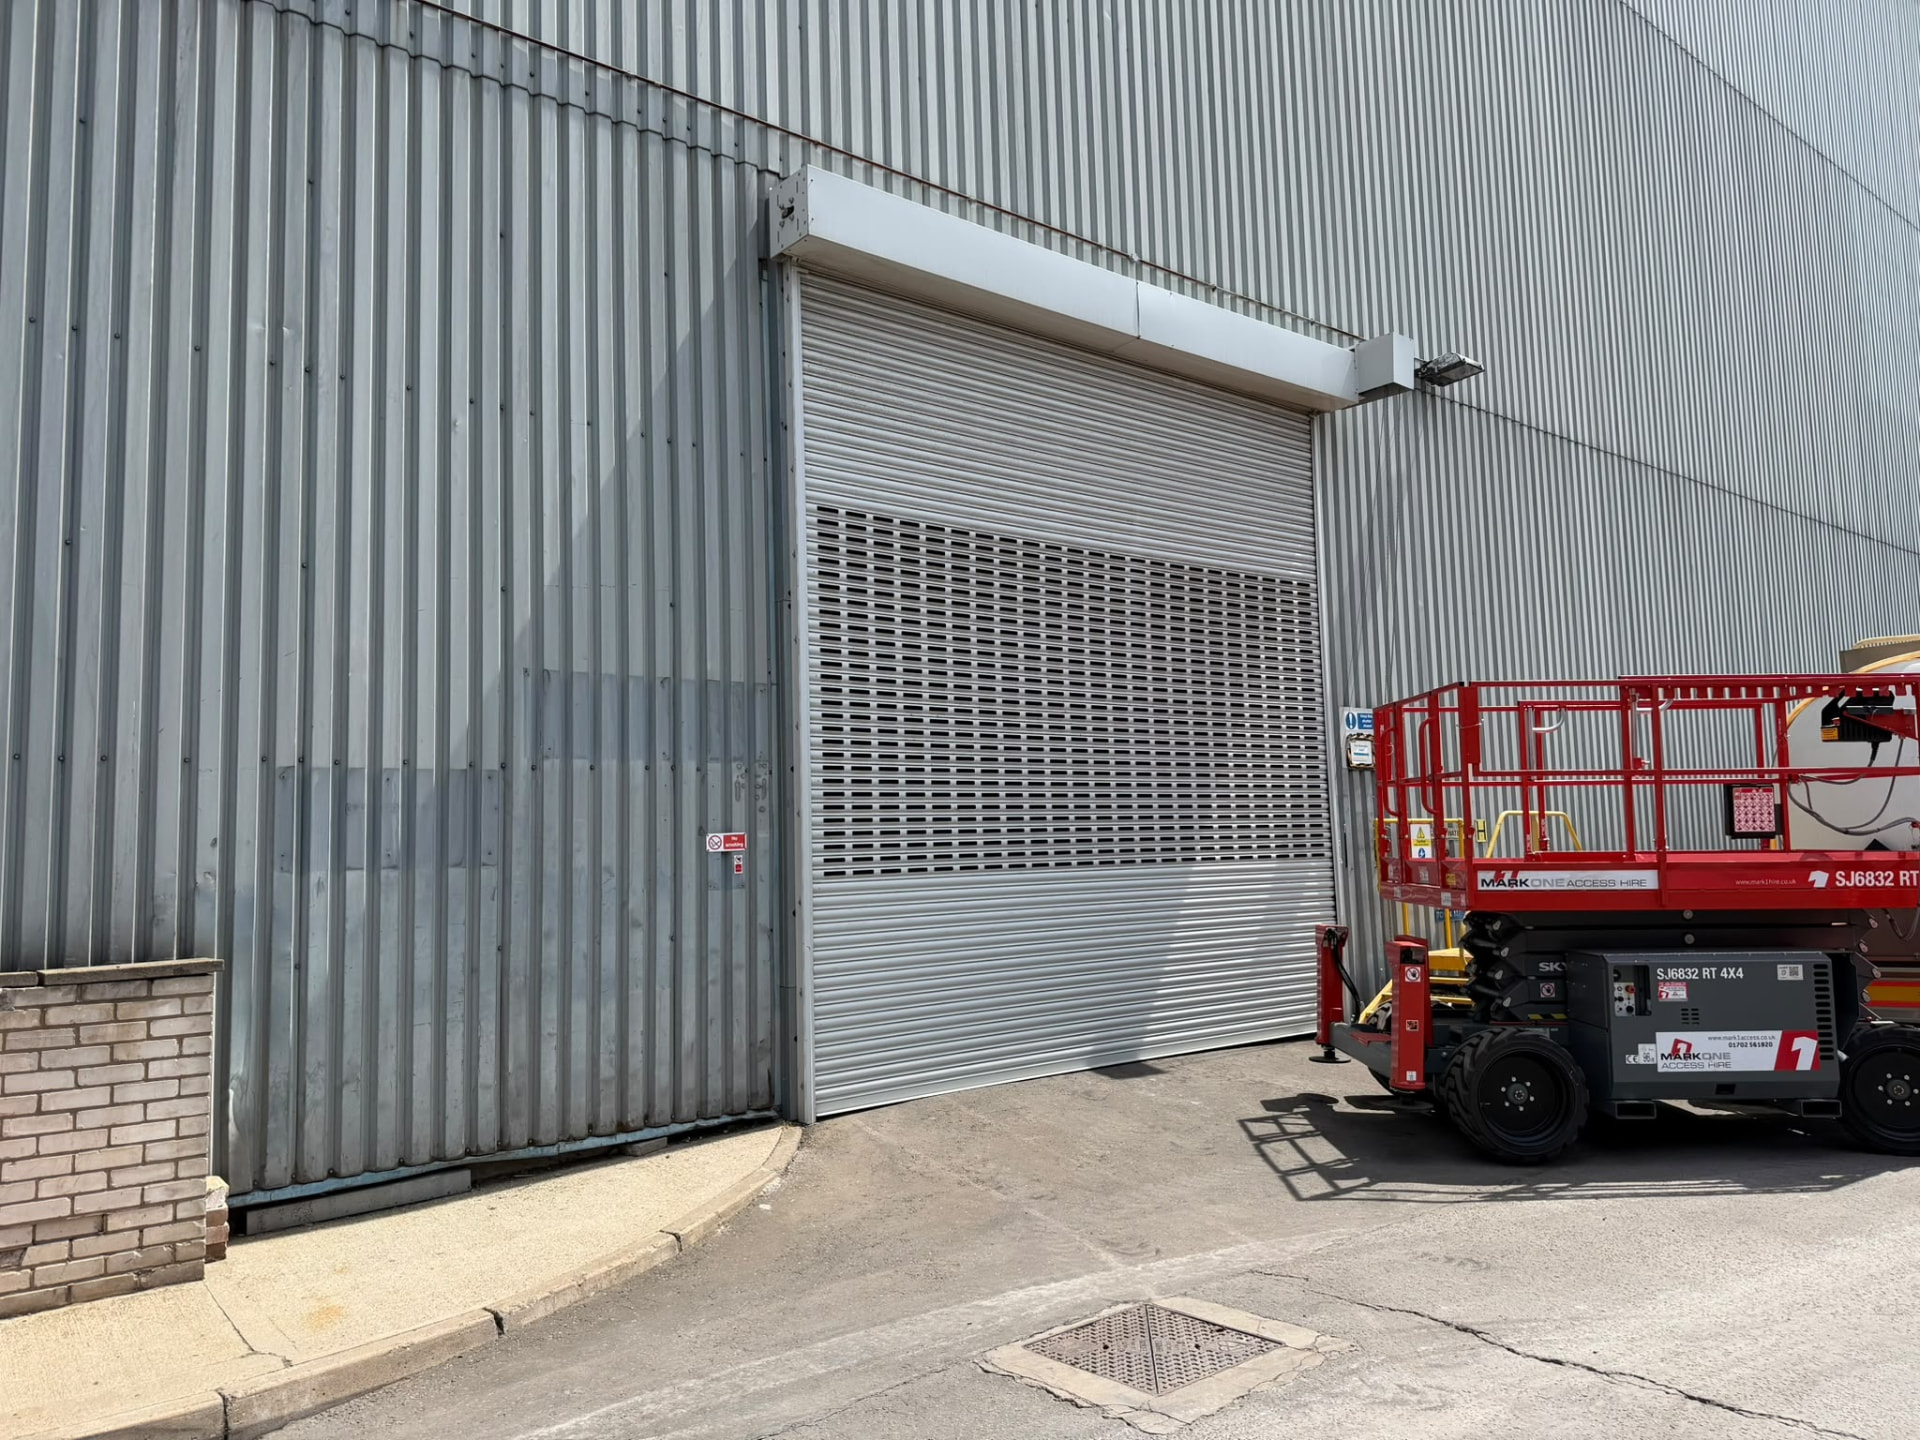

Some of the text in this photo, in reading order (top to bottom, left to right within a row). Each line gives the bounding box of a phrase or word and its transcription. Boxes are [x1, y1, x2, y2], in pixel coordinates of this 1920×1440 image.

[1566, 879, 1616, 888] ACCESS
[1620, 879, 1647, 887] HIRE
[1835, 870, 1895, 887] SJ6832
[1899, 870, 1919, 887] RT
[1656, 967, 1744, 980] SJ6832 RT 4X4
[1661, 1061, 1732, 1069] ACCESS HIRE
